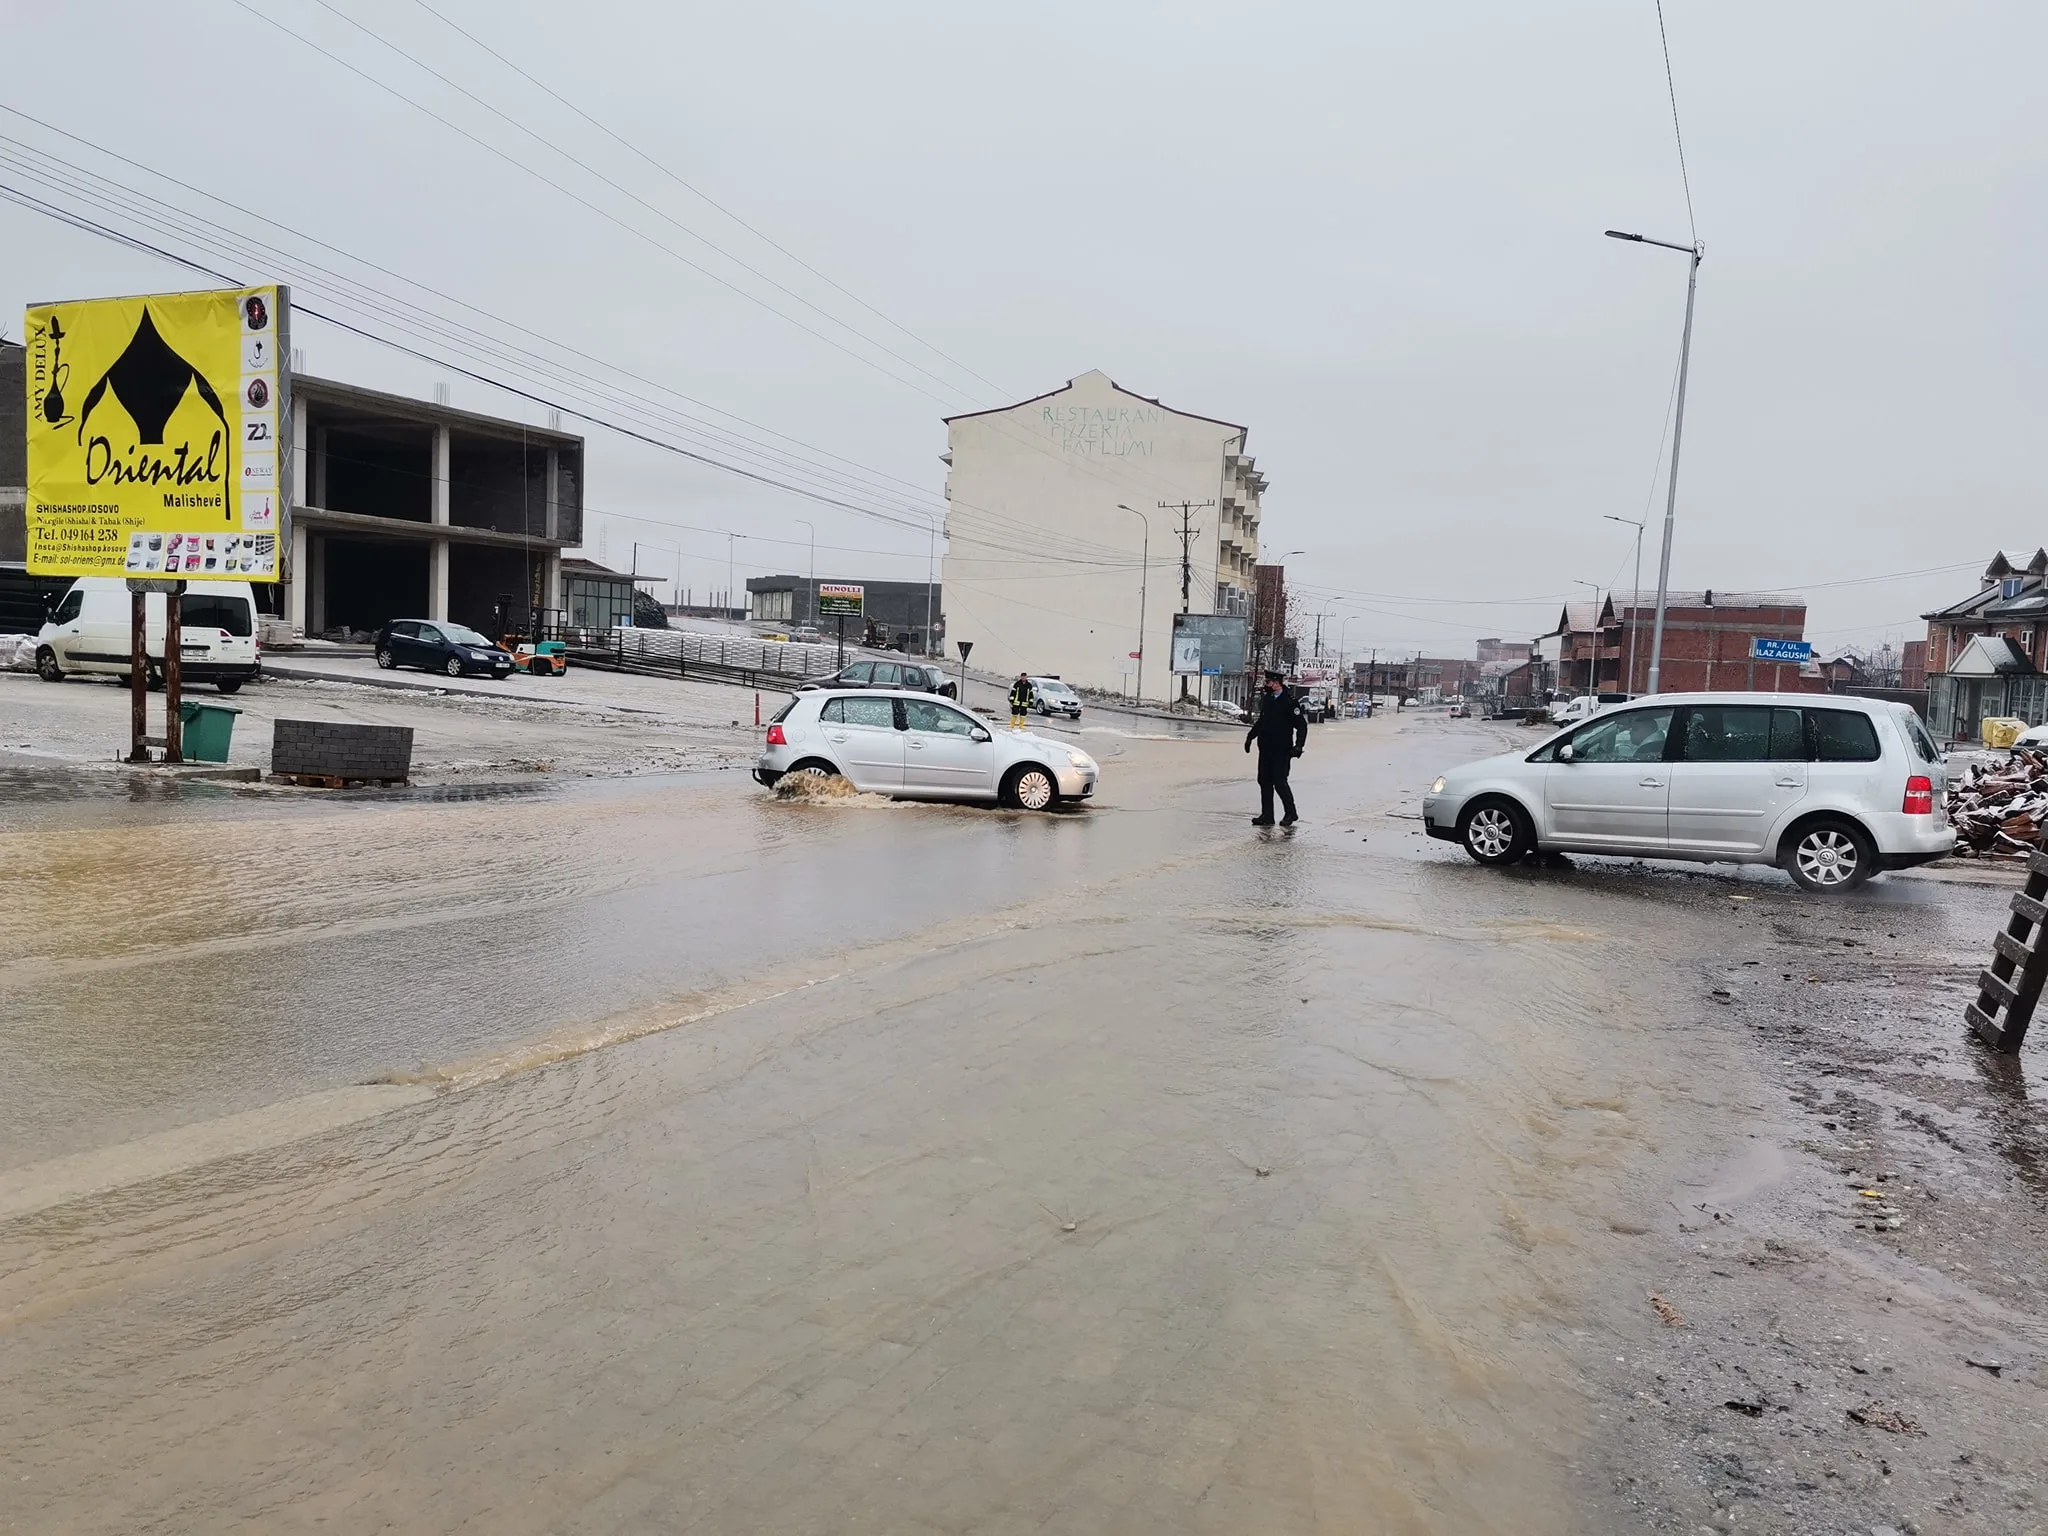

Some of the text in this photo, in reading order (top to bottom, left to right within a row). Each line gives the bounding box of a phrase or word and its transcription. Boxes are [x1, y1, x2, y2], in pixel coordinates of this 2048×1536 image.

[34, 326, 47, 422] AMY DELUX
[1062, 440, 1153, 456] FATLUMI
[86, 430, 221, 486] Oriental
[163, 493, 221, 507] Malishevë
[99, 517, 121, 525] Tabak
[36, 527, 58, 540] Tel.
[97, 529, 118, 541] 238
[33, 553, 59, 563] E-mail:
[1756, 649, 1809, 660] ILAZ AGUSHI
